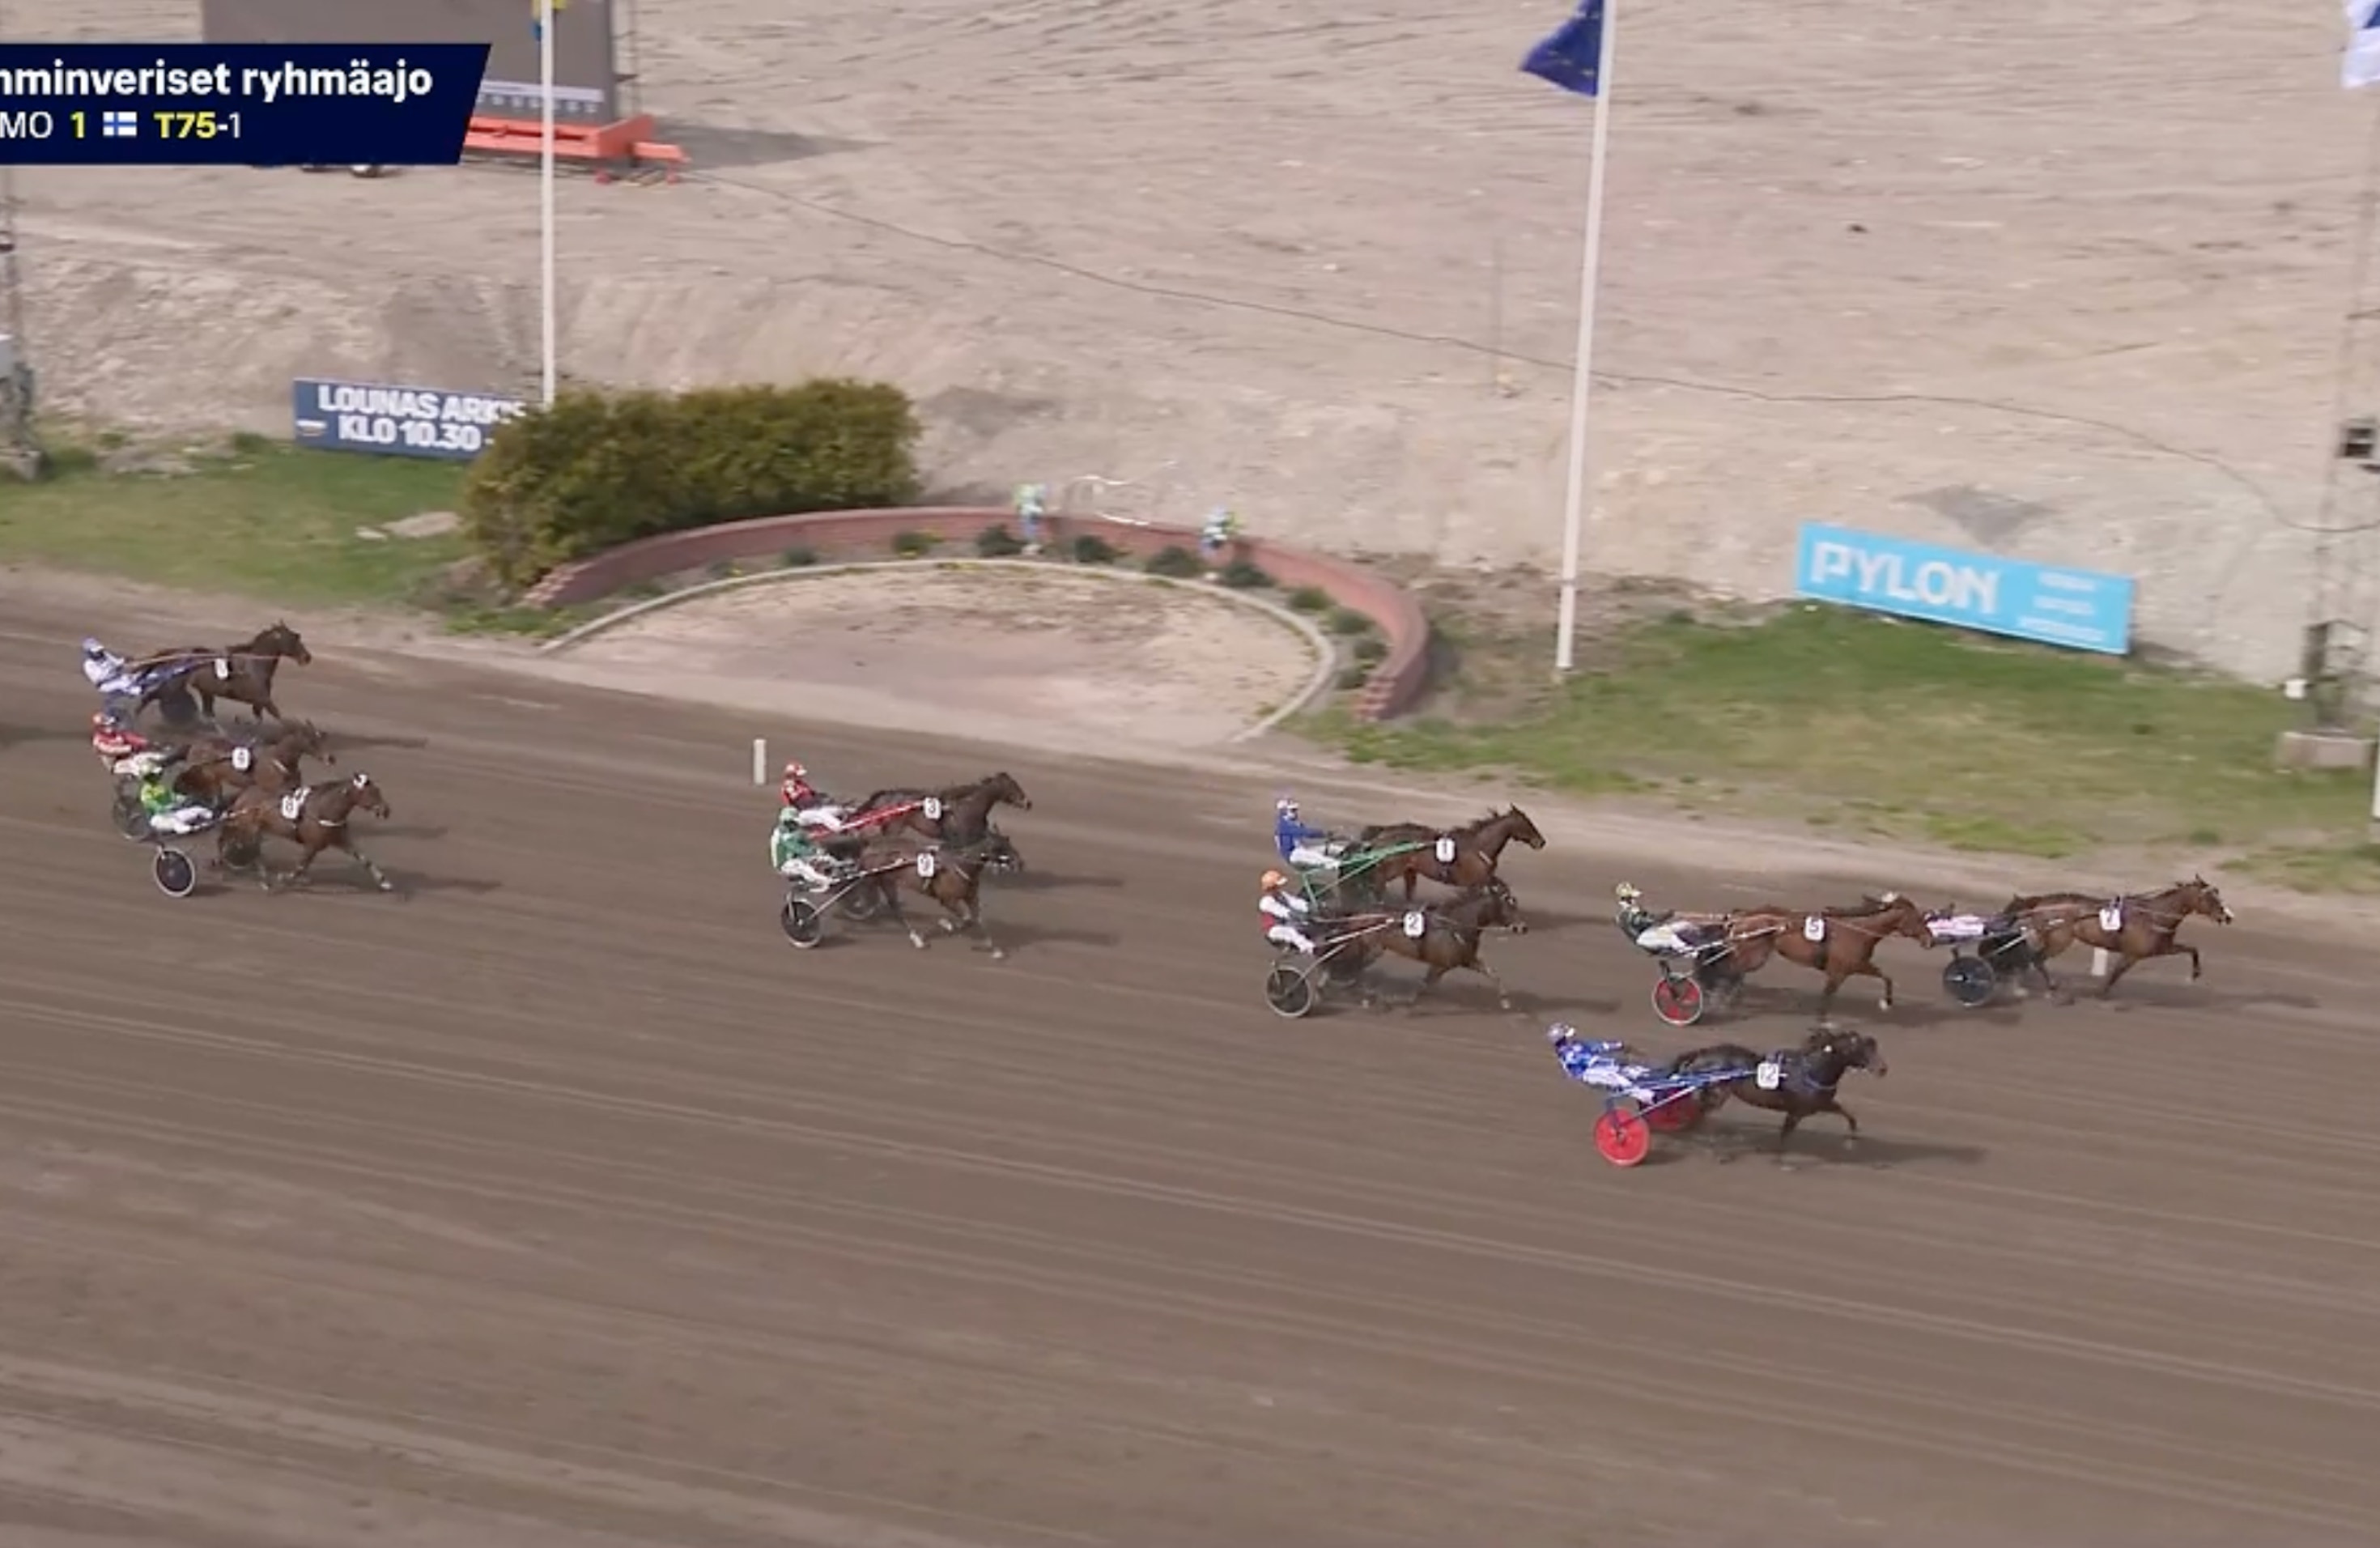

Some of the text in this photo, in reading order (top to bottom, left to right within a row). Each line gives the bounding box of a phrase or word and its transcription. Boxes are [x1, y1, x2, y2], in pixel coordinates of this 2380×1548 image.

[317, 385, 439, 419] LOUNAS
[338, 415, 397, 444] KLO
[399, 420, 482, 452] 10.30
[1810, 541, 2000, 615] PYLON
